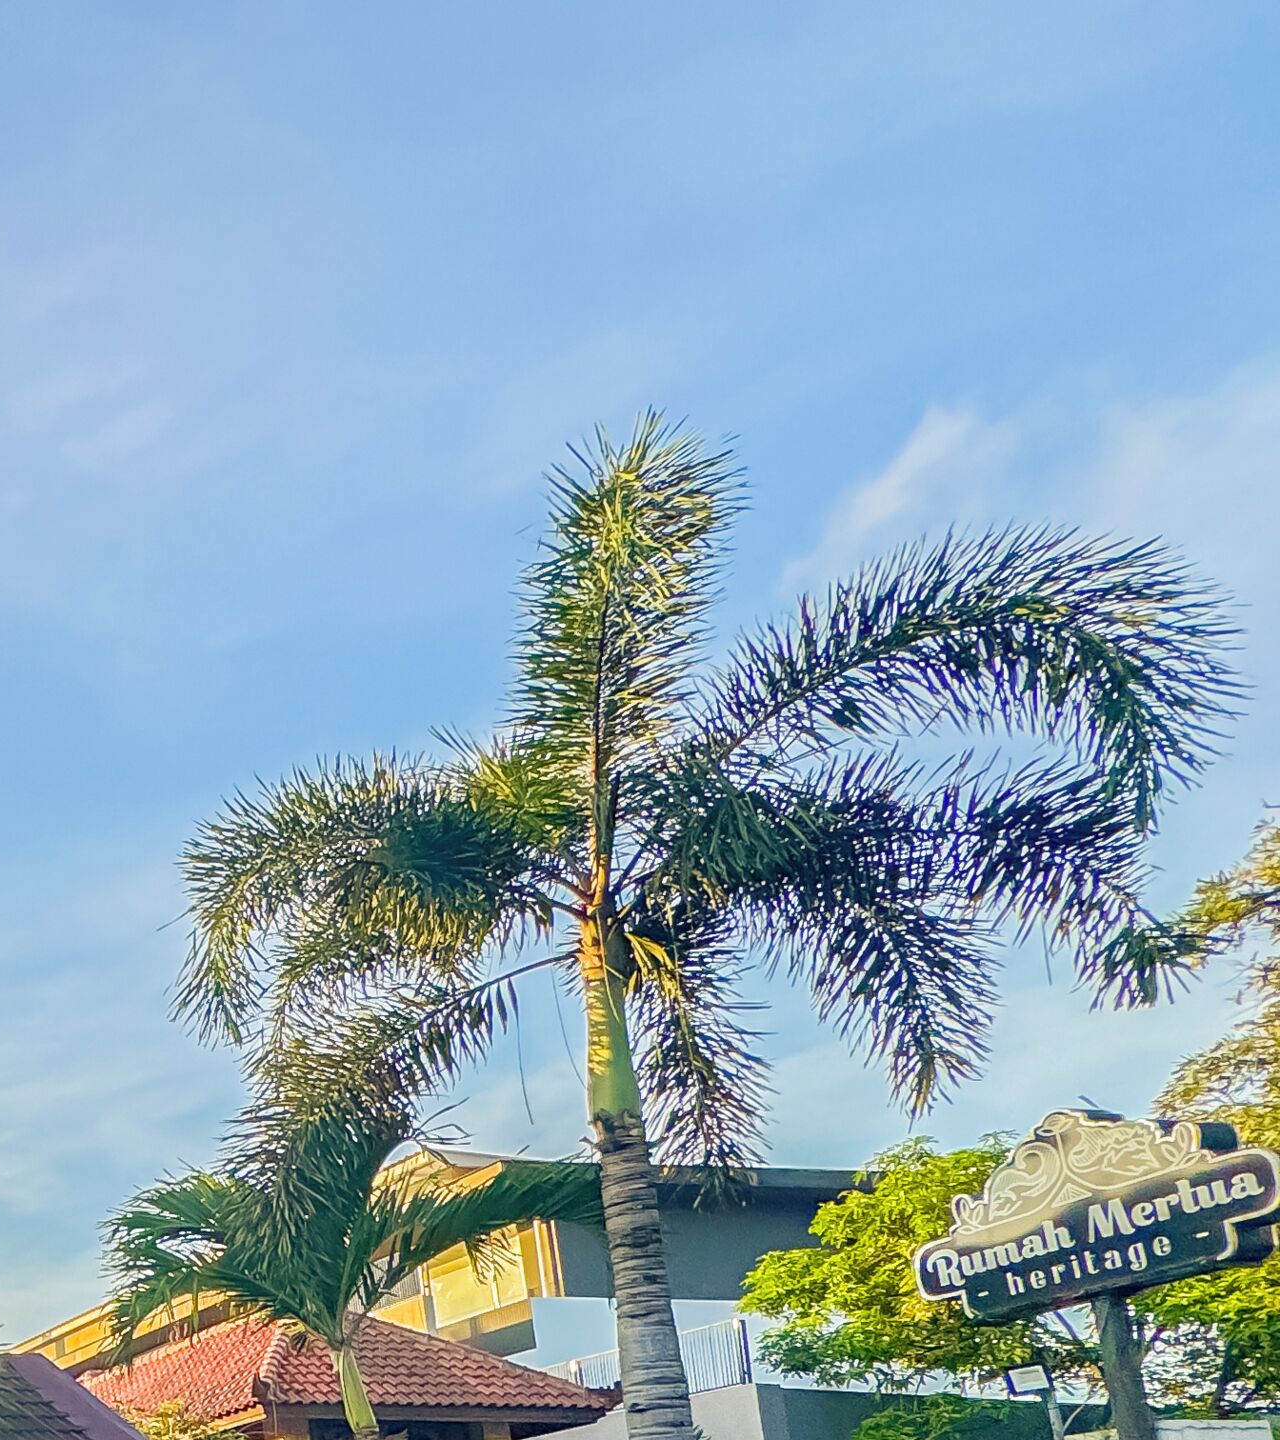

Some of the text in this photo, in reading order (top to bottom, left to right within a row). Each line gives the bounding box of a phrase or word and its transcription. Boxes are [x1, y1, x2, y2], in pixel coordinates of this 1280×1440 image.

[926, 1172, 1265, 1288] Rumah Mertua
[1005, 1235, 1172, 1297] heritage
